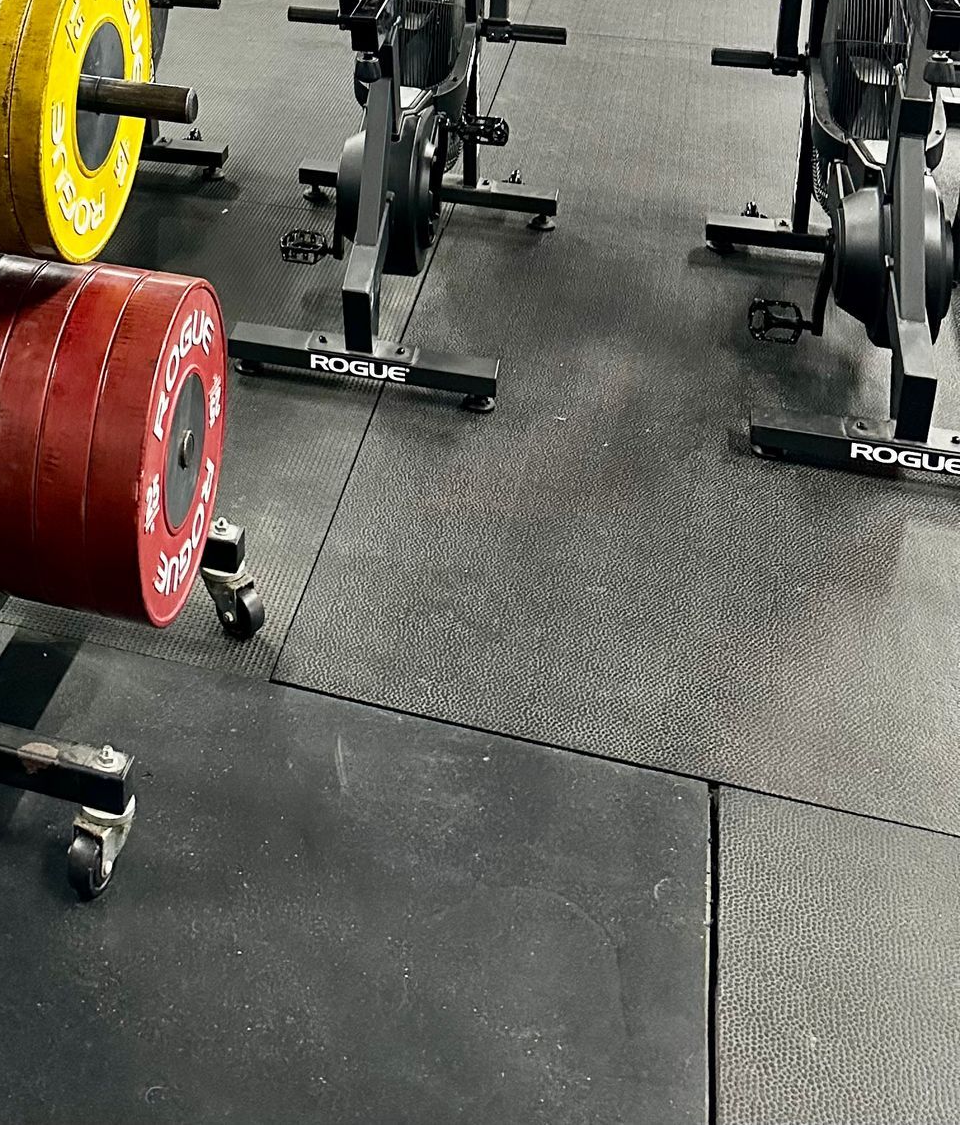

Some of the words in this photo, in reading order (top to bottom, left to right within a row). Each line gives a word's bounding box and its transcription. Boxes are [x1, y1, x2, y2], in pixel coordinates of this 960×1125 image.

[50, 101, 107, 236] ROGUE
[152, 308, 215, 443] ROGUE
[310, 354, 409, 382] ROGUE
[152, 456, 216, 596] ROGUE
[850, 442, 960, 475] ROGUE
